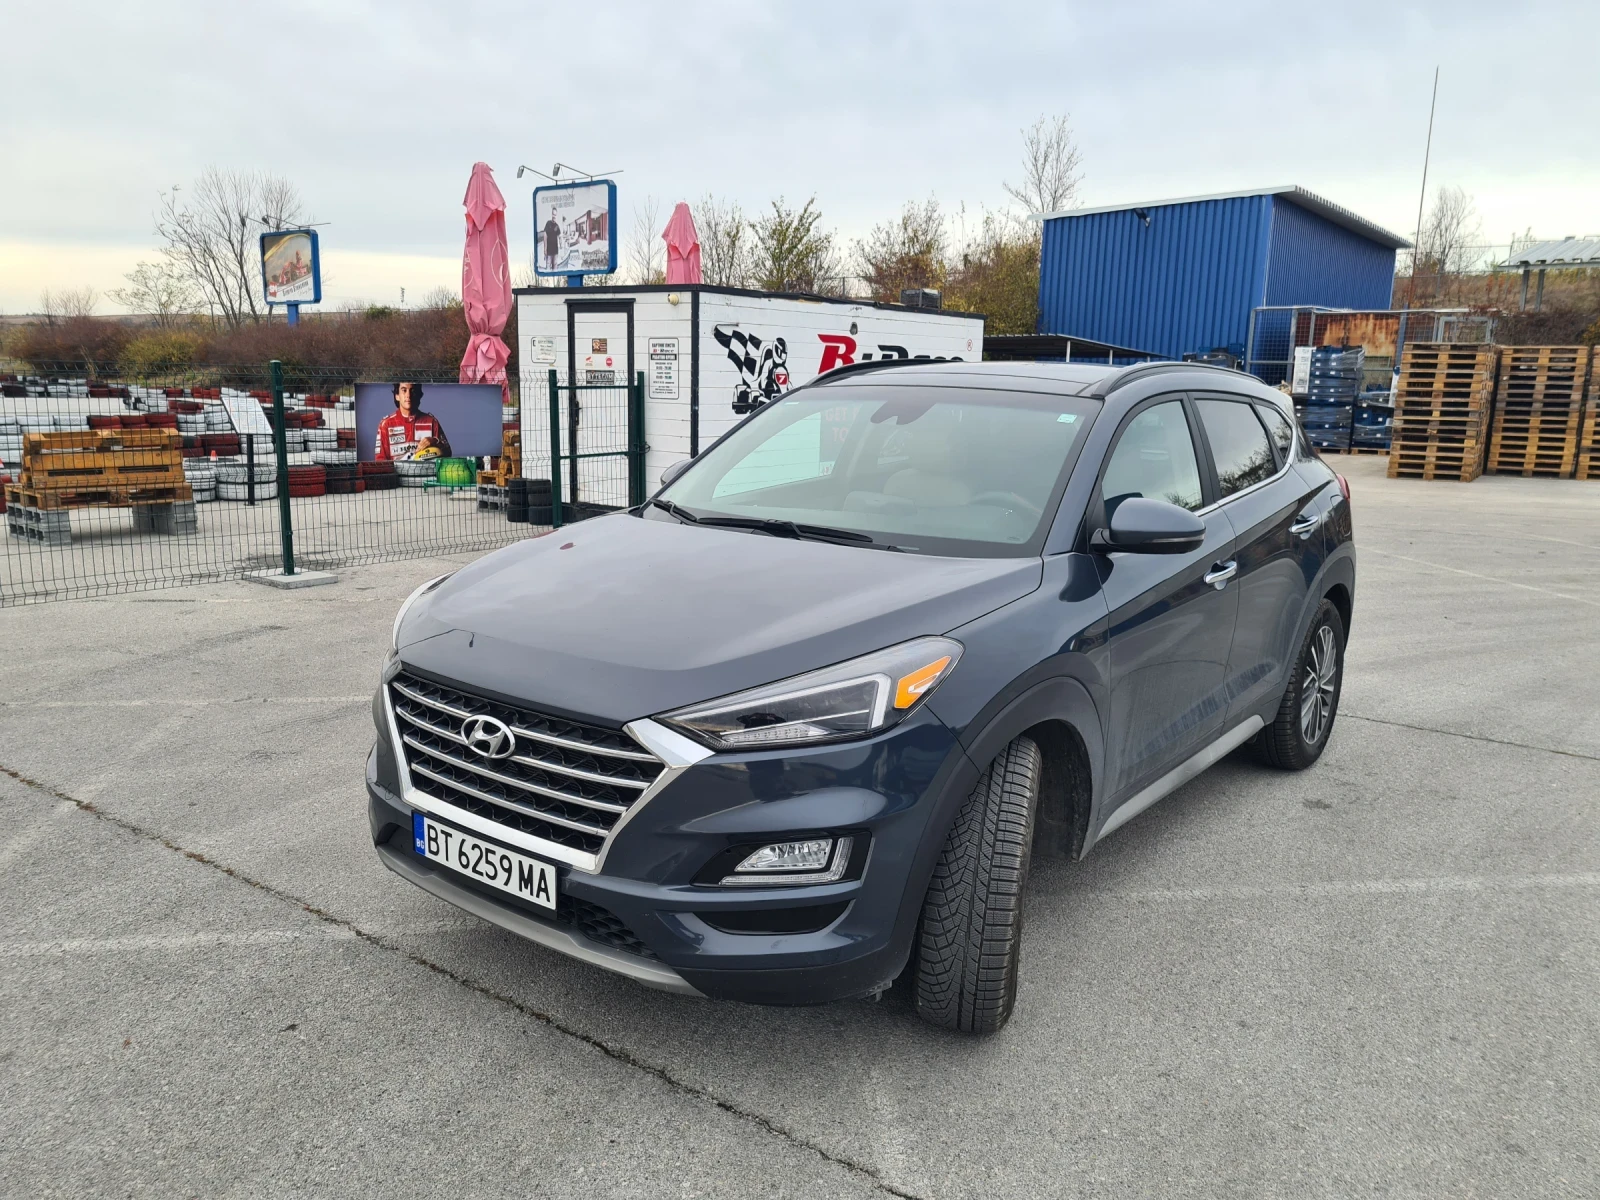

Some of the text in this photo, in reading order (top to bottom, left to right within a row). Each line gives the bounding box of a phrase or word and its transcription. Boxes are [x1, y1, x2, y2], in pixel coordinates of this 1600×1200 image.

[778, 375, 786, 384] 7
[416, 837, 425, 850] BG
[426, 823, 551, 903] BT 6259 MA
